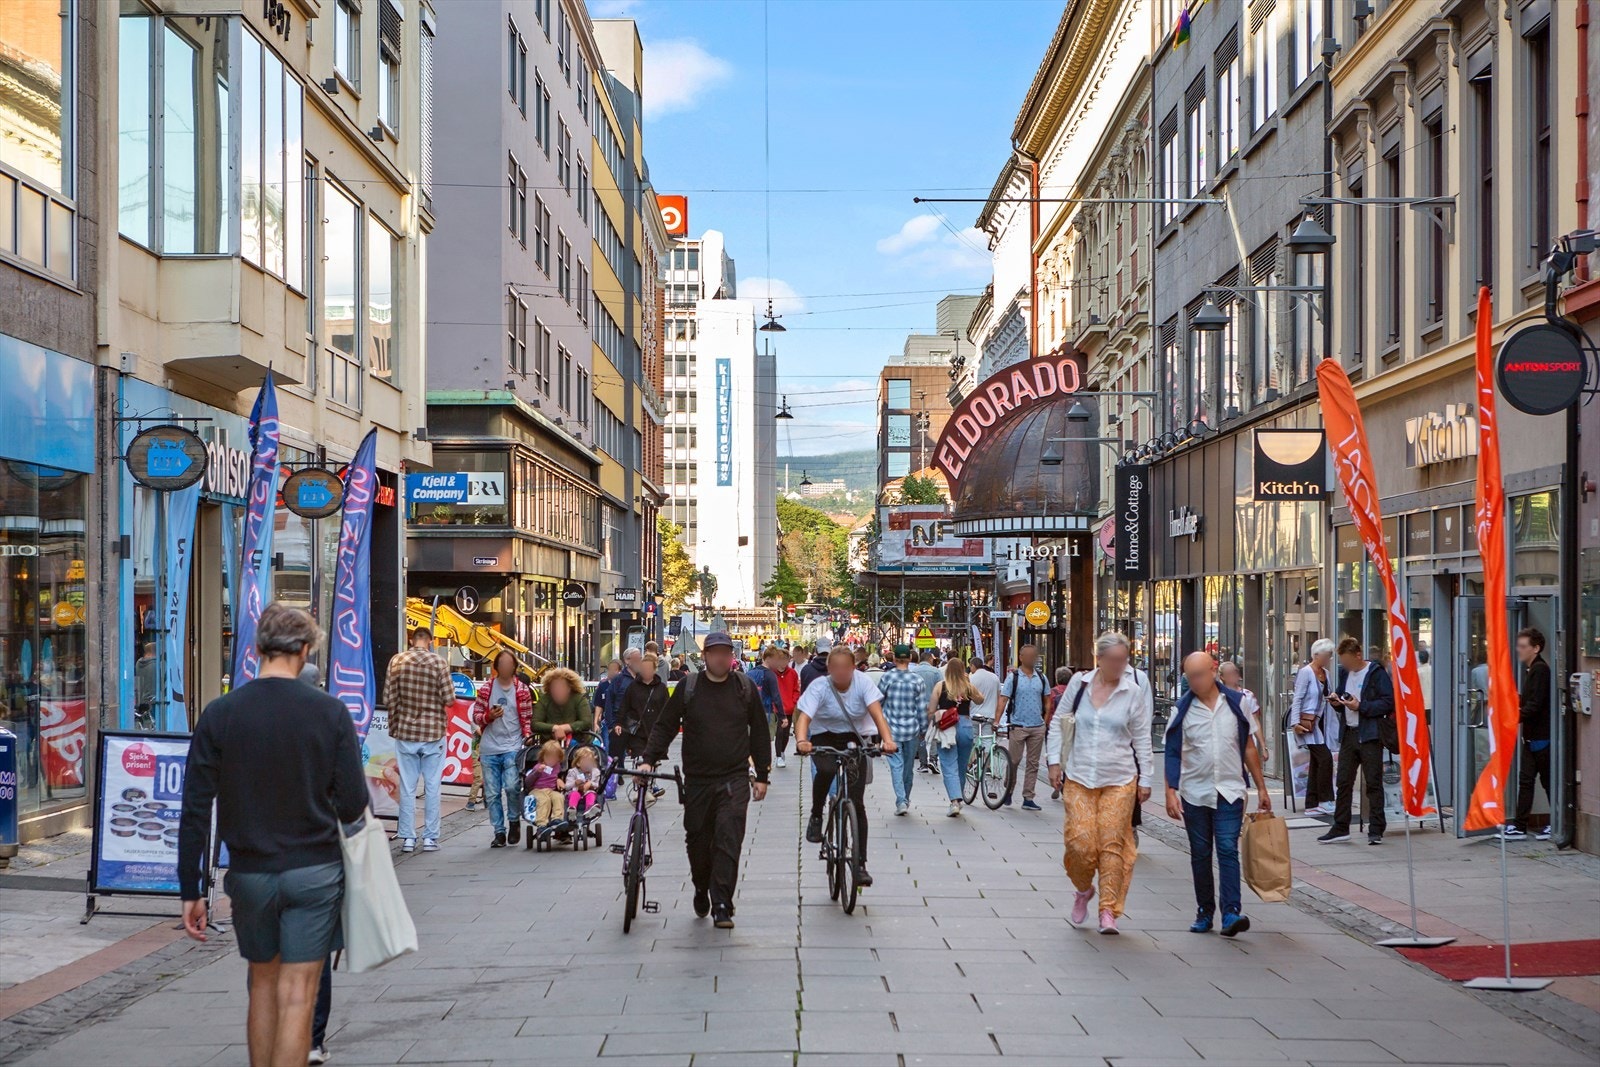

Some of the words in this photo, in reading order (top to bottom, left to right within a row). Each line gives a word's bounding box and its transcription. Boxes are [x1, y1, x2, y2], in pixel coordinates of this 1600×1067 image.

[263, 0, 291, 41] 1897
[1505, 361, 1582, 372] ANTONSPORT
[938, 359, 1080, 480] ELDORADO
[422, 476, 446, 488] Kjell
[448, 476, 455, 487] &
[413, 488, 464, 500] Company
[1125, 475, 1143, 571] Home&Cottage
[1023, 537, 1080, 557] norli
[129, 752, 149, 761] Sjekk
[159, 762, 185, 795] 10
